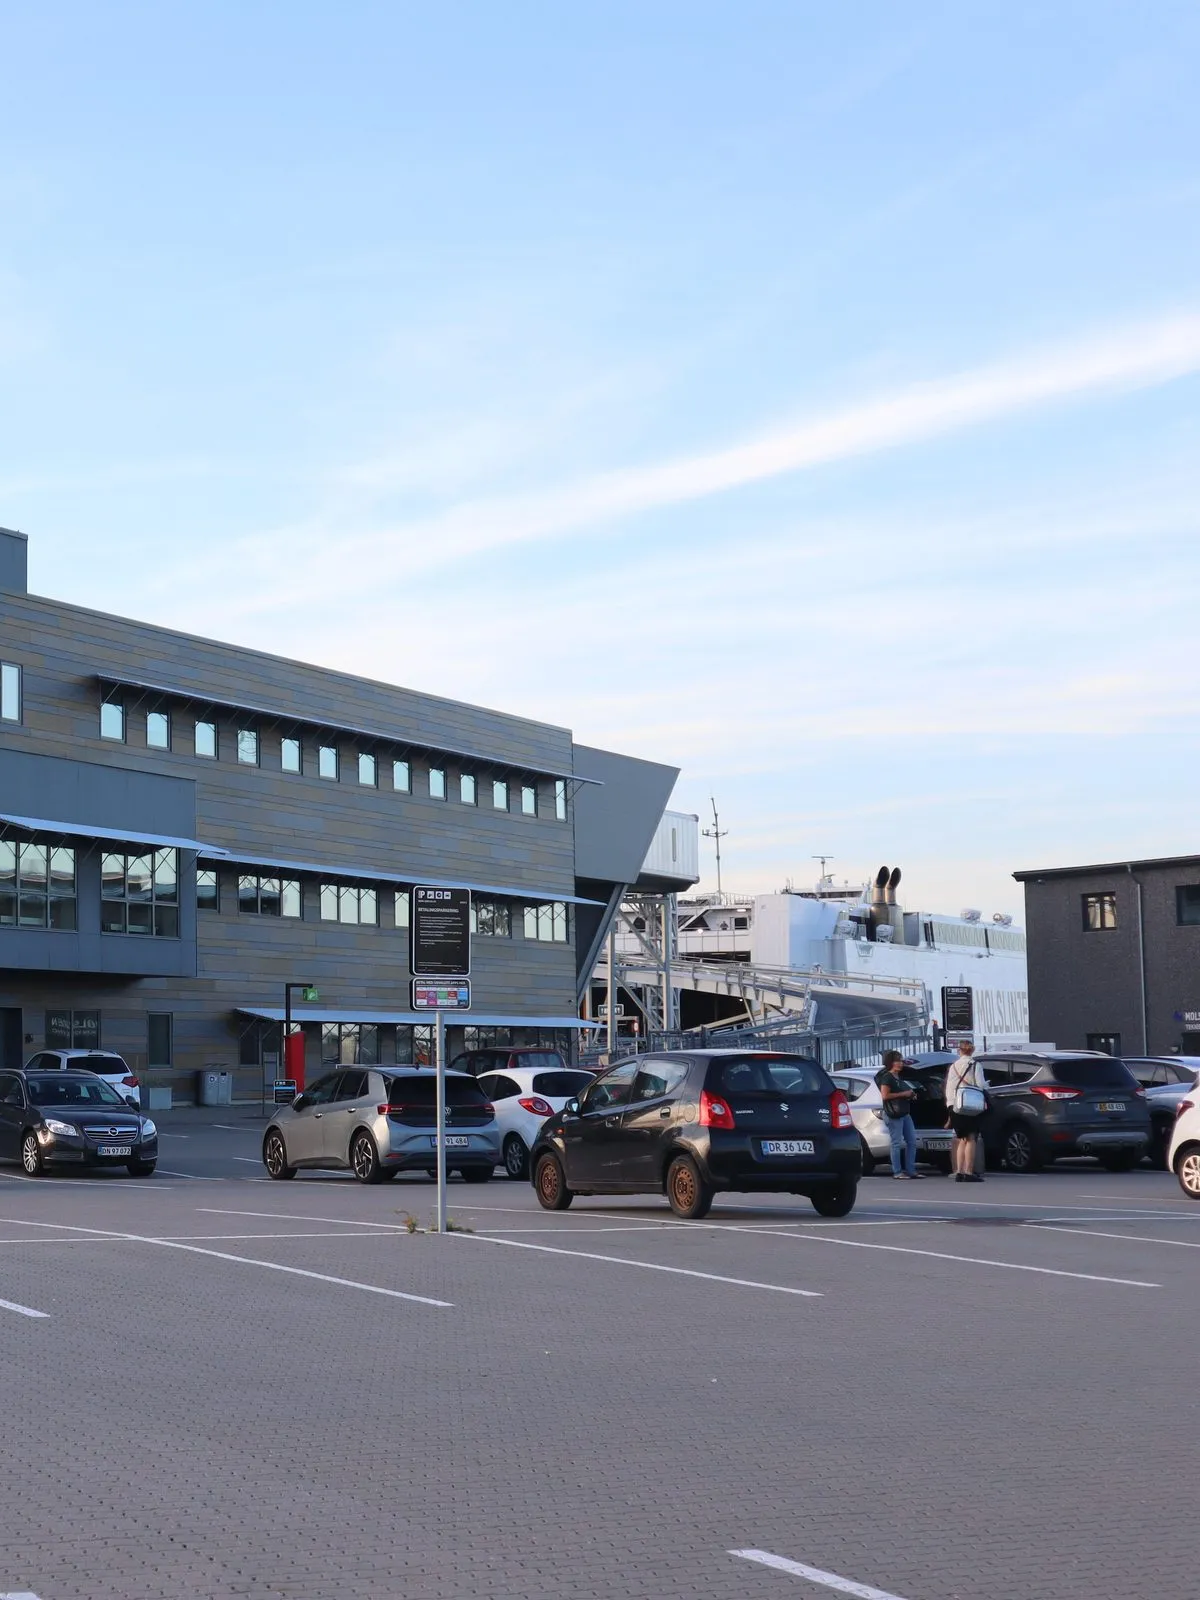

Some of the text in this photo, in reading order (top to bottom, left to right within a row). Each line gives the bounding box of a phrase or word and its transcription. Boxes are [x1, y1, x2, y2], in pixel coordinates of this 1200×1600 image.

[768, 1142, 813, 1152] DR 36 142
